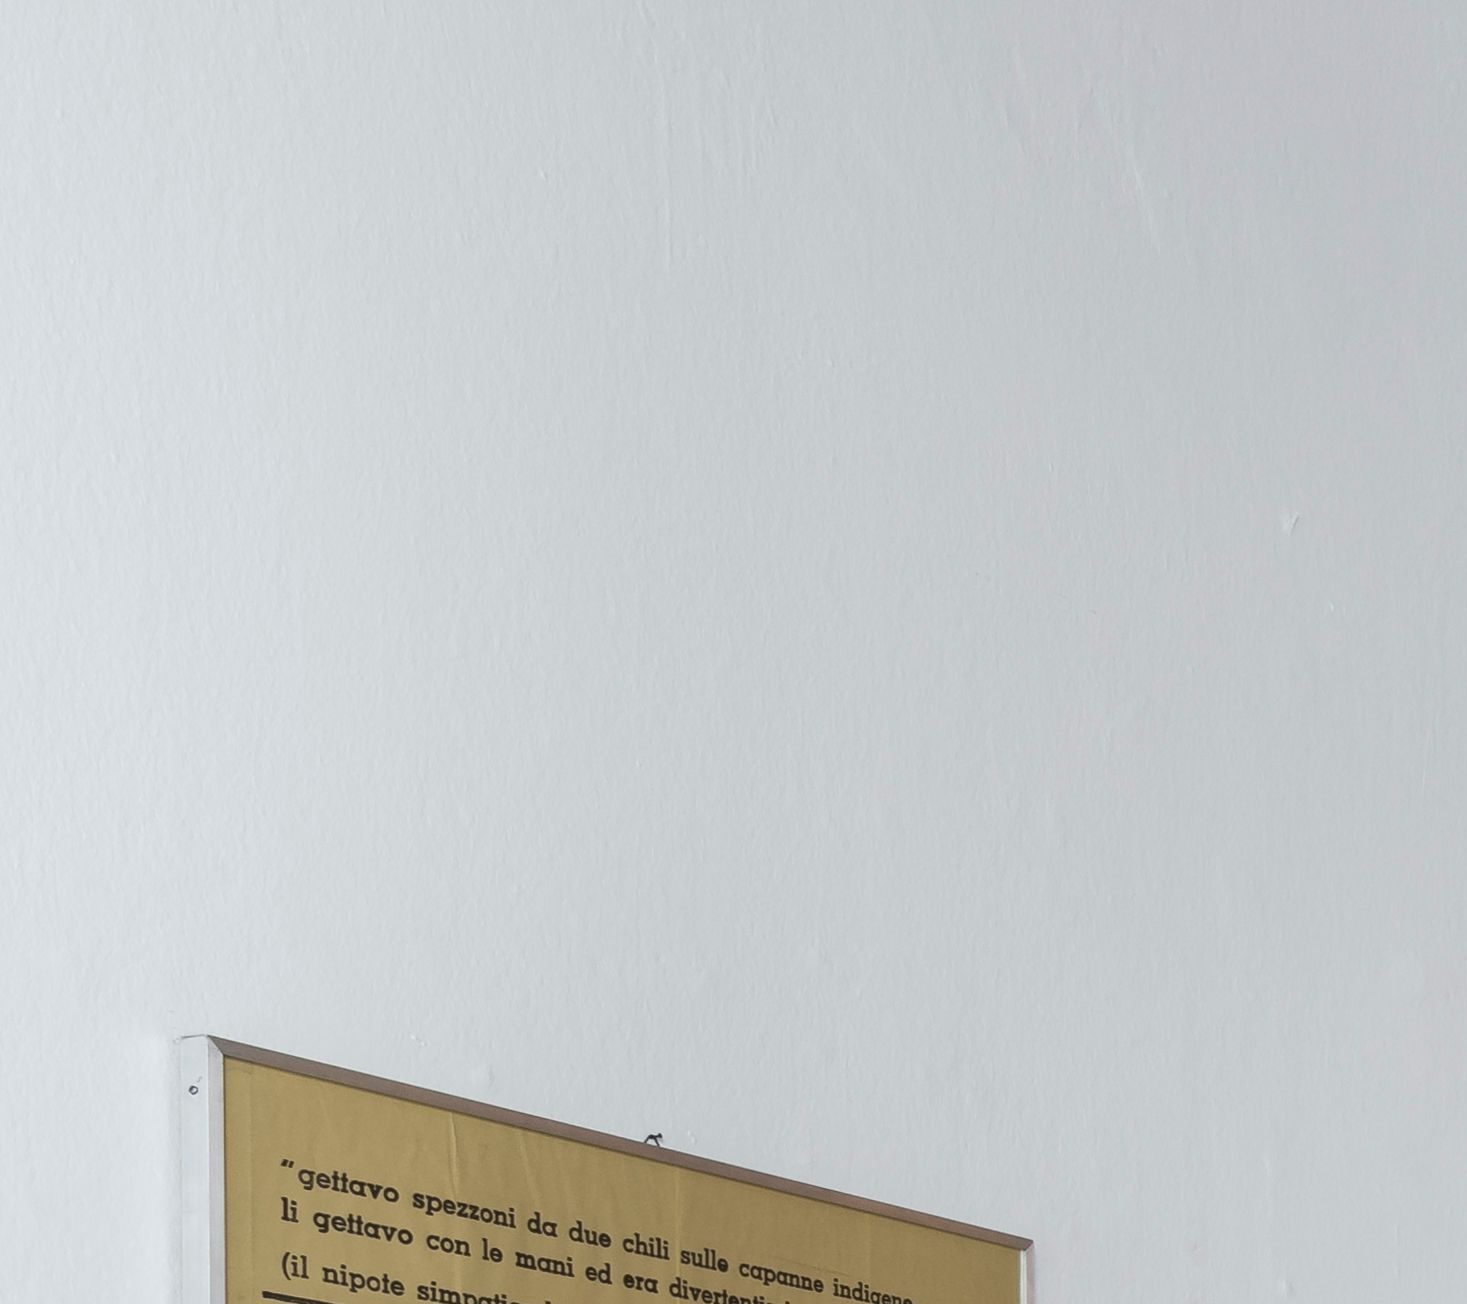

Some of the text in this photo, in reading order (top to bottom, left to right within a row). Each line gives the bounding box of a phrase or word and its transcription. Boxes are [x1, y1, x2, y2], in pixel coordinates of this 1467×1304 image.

[281, 1197, 299, 1223] li
[312, 1212, 413, 1245] gettavo
[424, 1234, 472, 1257] con
[479, 1237, 503, 1263] le
[515, 1251, 575, 1278] mani
[585, 1262, 613, 1285] ed
[623, 1274, 659, 1294] era
[282, 1252, 310, 1281] (il
[322, 1264, 405, 1296] nipote
[412, 1193, 517, 1229] spezzoni
[526, 1211, 558, 1238] da
[568, 1220, 612, 1248] due
[622, 1232, 670, 1261] chili
[680, 1248, 729, 1273] sulle
[738, 1263, 824, 1293] capanne
